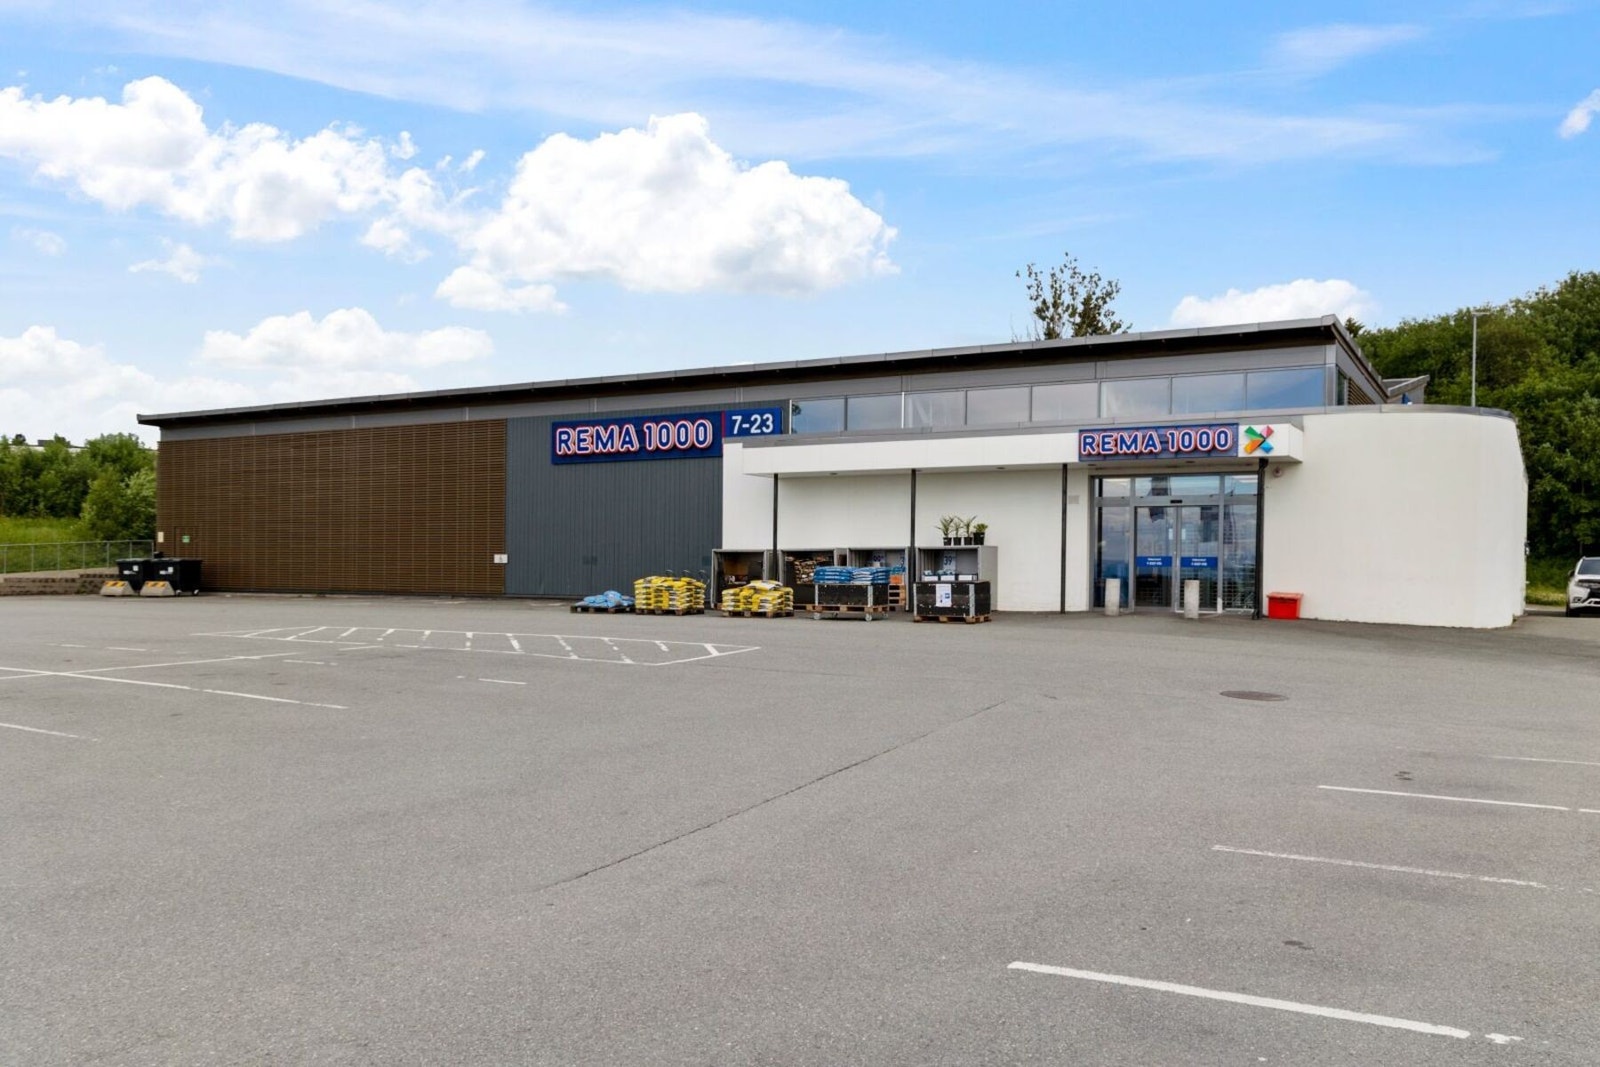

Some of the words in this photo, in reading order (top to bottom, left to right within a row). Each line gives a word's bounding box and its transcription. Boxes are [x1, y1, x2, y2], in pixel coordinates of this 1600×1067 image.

[732, 413, 774, 434] 7-23
[557, 425, 639, 455] REMA
[644, 420, 712, 451] 1000
[1081, 432, 1161, 454] REMA
[1167, 428, 1232, 451] 1000
